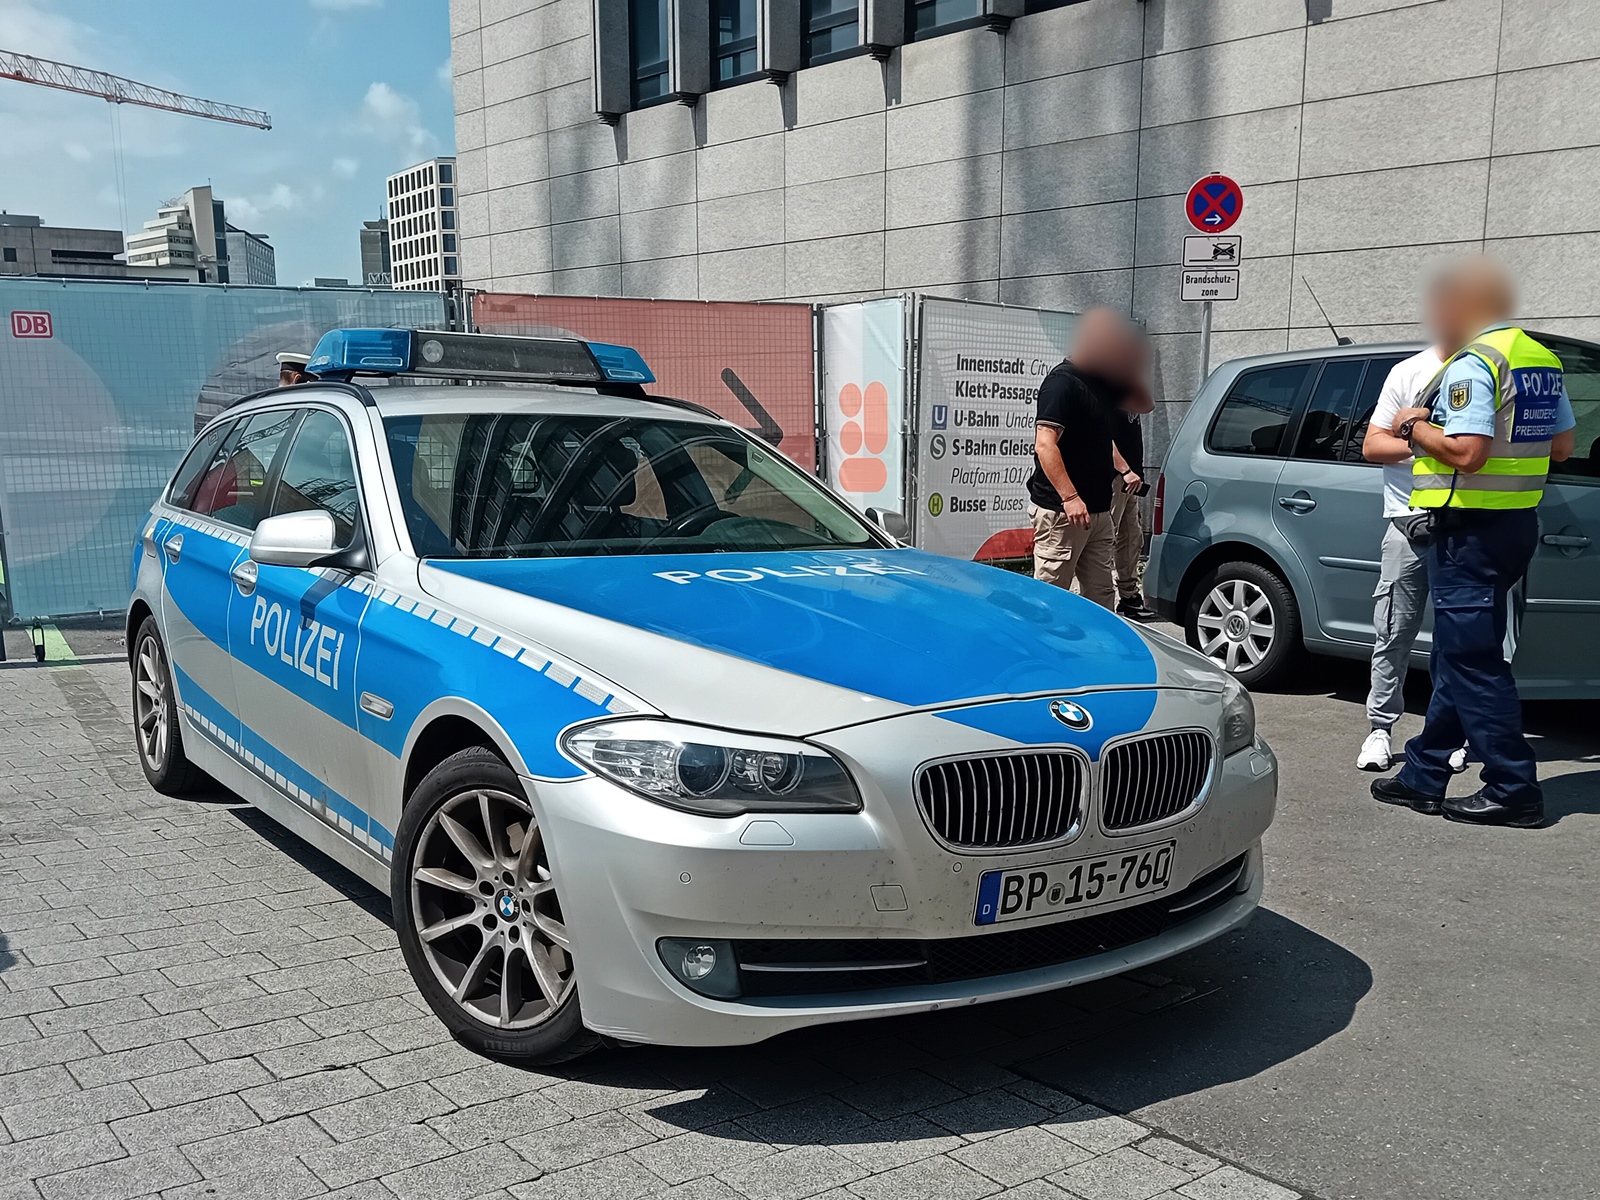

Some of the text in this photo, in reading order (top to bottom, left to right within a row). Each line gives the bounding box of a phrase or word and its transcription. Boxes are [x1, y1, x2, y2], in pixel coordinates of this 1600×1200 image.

[1185, 274, 1235, 284] Brandschutz-
[16, 315, 48, 334] DB
[957, 354, 1024, 374] Innenstadt
[955, 381, 1039, 404] Klett-Passage
[1521, 372, 1562, 396] POLIZE
[954, 410, 1036, 429] U-Bahn Unde
[952, 438, 1036, 456] S-Bahn Gleise
[951, 467, 1000, 487] Platform
[950, 495, 1023, 512] Busse Buses
[653, 563, 928, 585] POLIZEI
[251, 595, 344, 690] POLIZEI
[982, 847, 1172, 916] D BP 15-760
